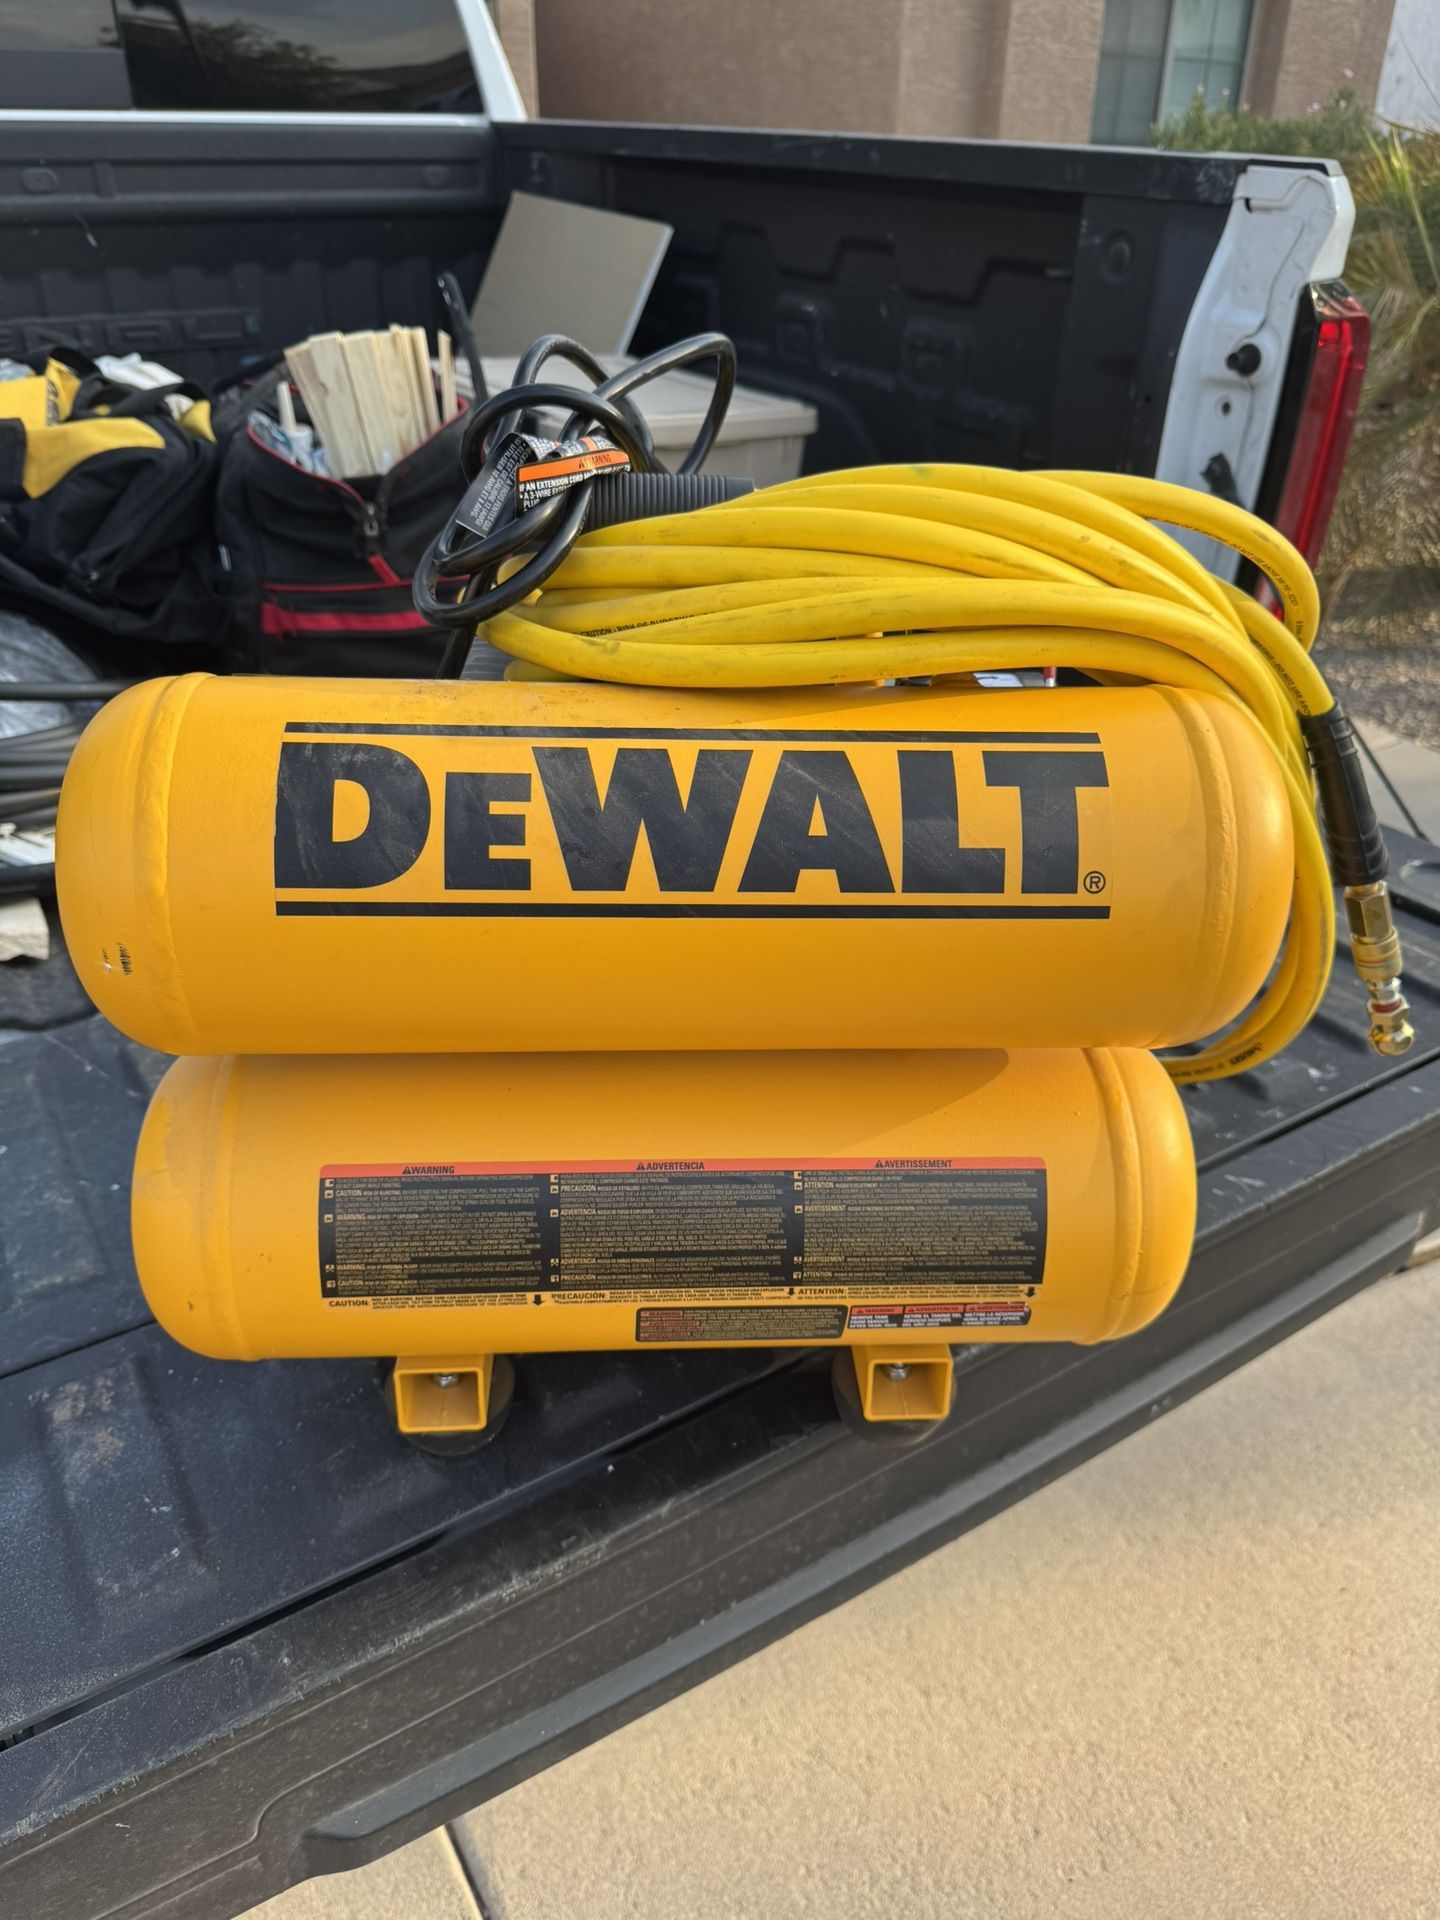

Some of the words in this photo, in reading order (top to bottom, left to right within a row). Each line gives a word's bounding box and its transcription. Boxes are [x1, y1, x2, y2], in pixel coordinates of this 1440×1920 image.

[525, 482, 536, 491] AN
[537, 477, 569, 490] EXTENSION
[274, 742, 1109, 894] DEWALT
[646, 1162, 705, 1170] ADVERTENCIA
[884, 1160, 952, 1168] AVERTISSEMENT
[411, 1166, 455, 1174] WARNING
